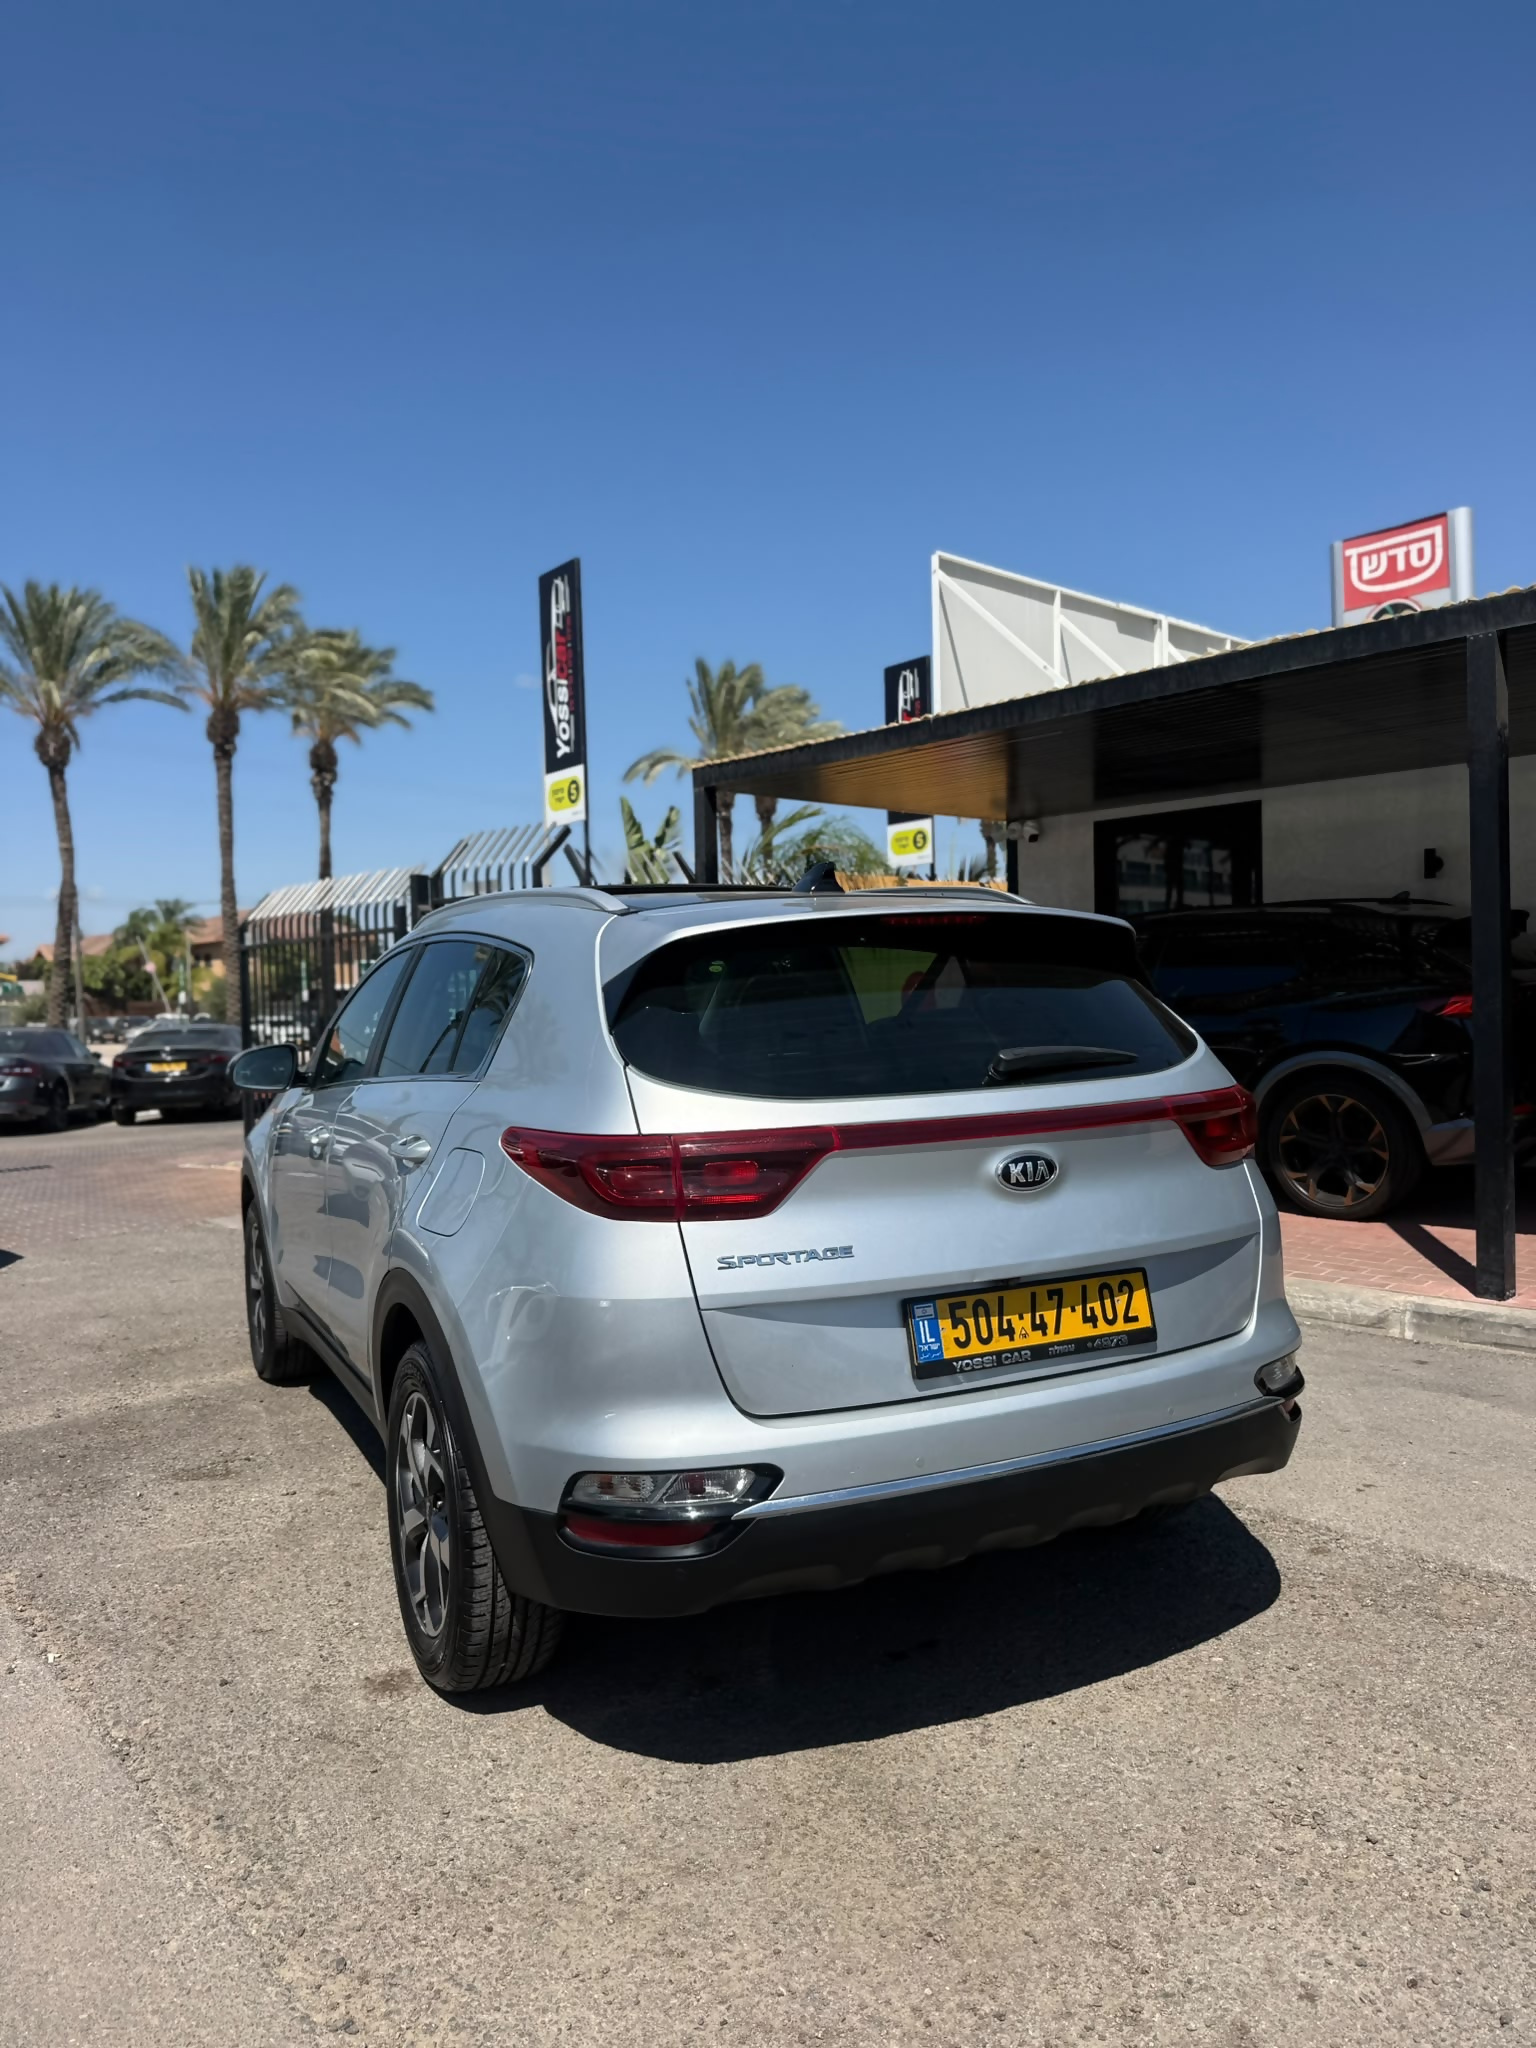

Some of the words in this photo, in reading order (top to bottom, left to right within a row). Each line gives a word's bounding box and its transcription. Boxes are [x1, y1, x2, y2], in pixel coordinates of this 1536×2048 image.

[1008, 1160, 1050, 1184] KIA
[717, 1245, 855, 1270] SPORTAGE
[919, 1320, 936, 1344] IL
[952, 1355, 997, 1372] YOSSI
[1001, 1350, 1032, 1364] CAR
